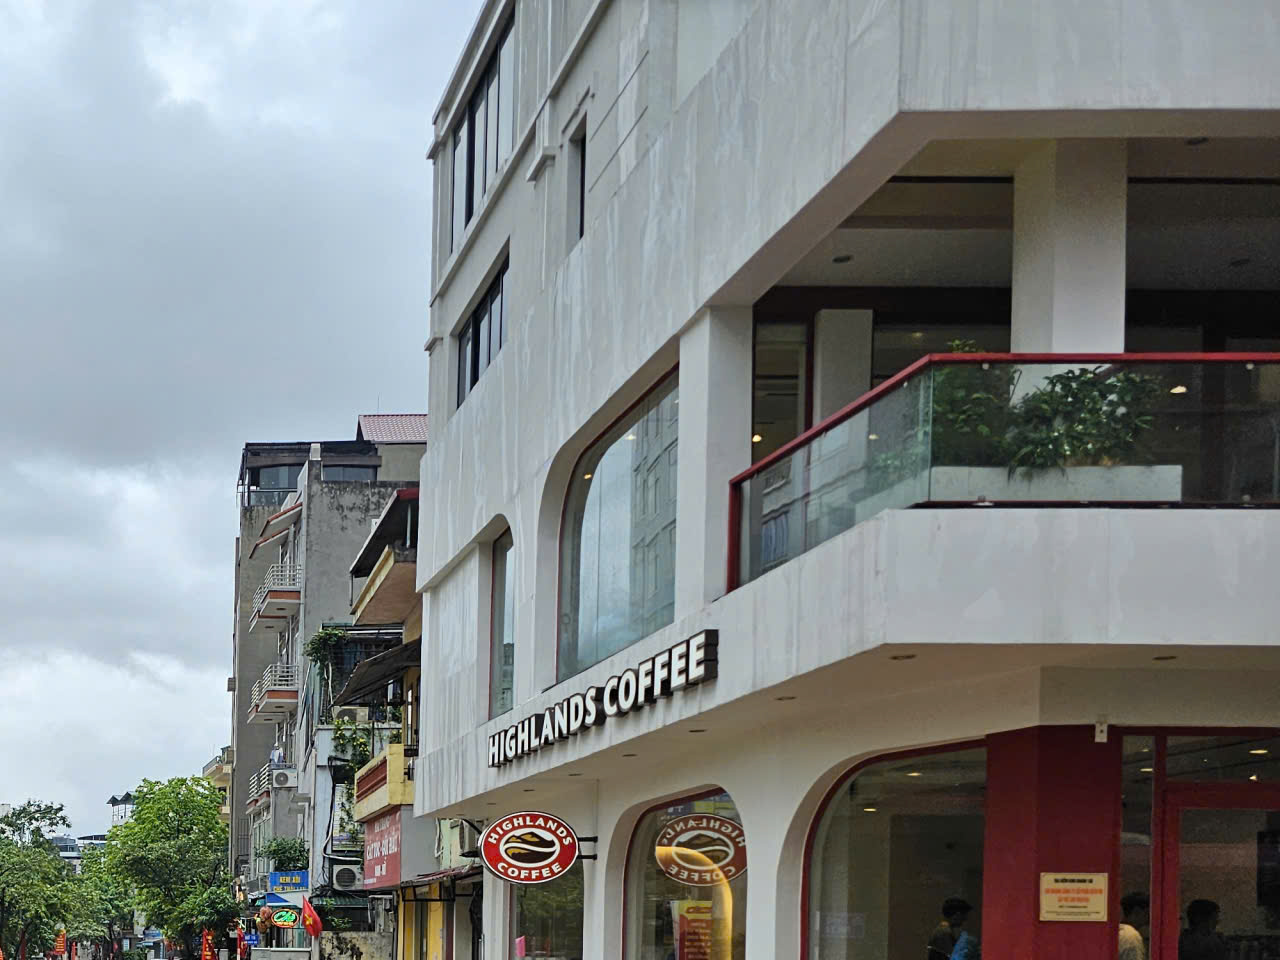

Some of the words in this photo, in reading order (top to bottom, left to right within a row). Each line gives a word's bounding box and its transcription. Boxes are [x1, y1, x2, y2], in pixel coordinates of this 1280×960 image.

[488, 685, 597, 768] HIGHLANDS
[603, 630, 708, 717] COFFEE
[488, 816, 573, 846] HIGHLANDS
[497, 862, 562, 879] COFFEE
